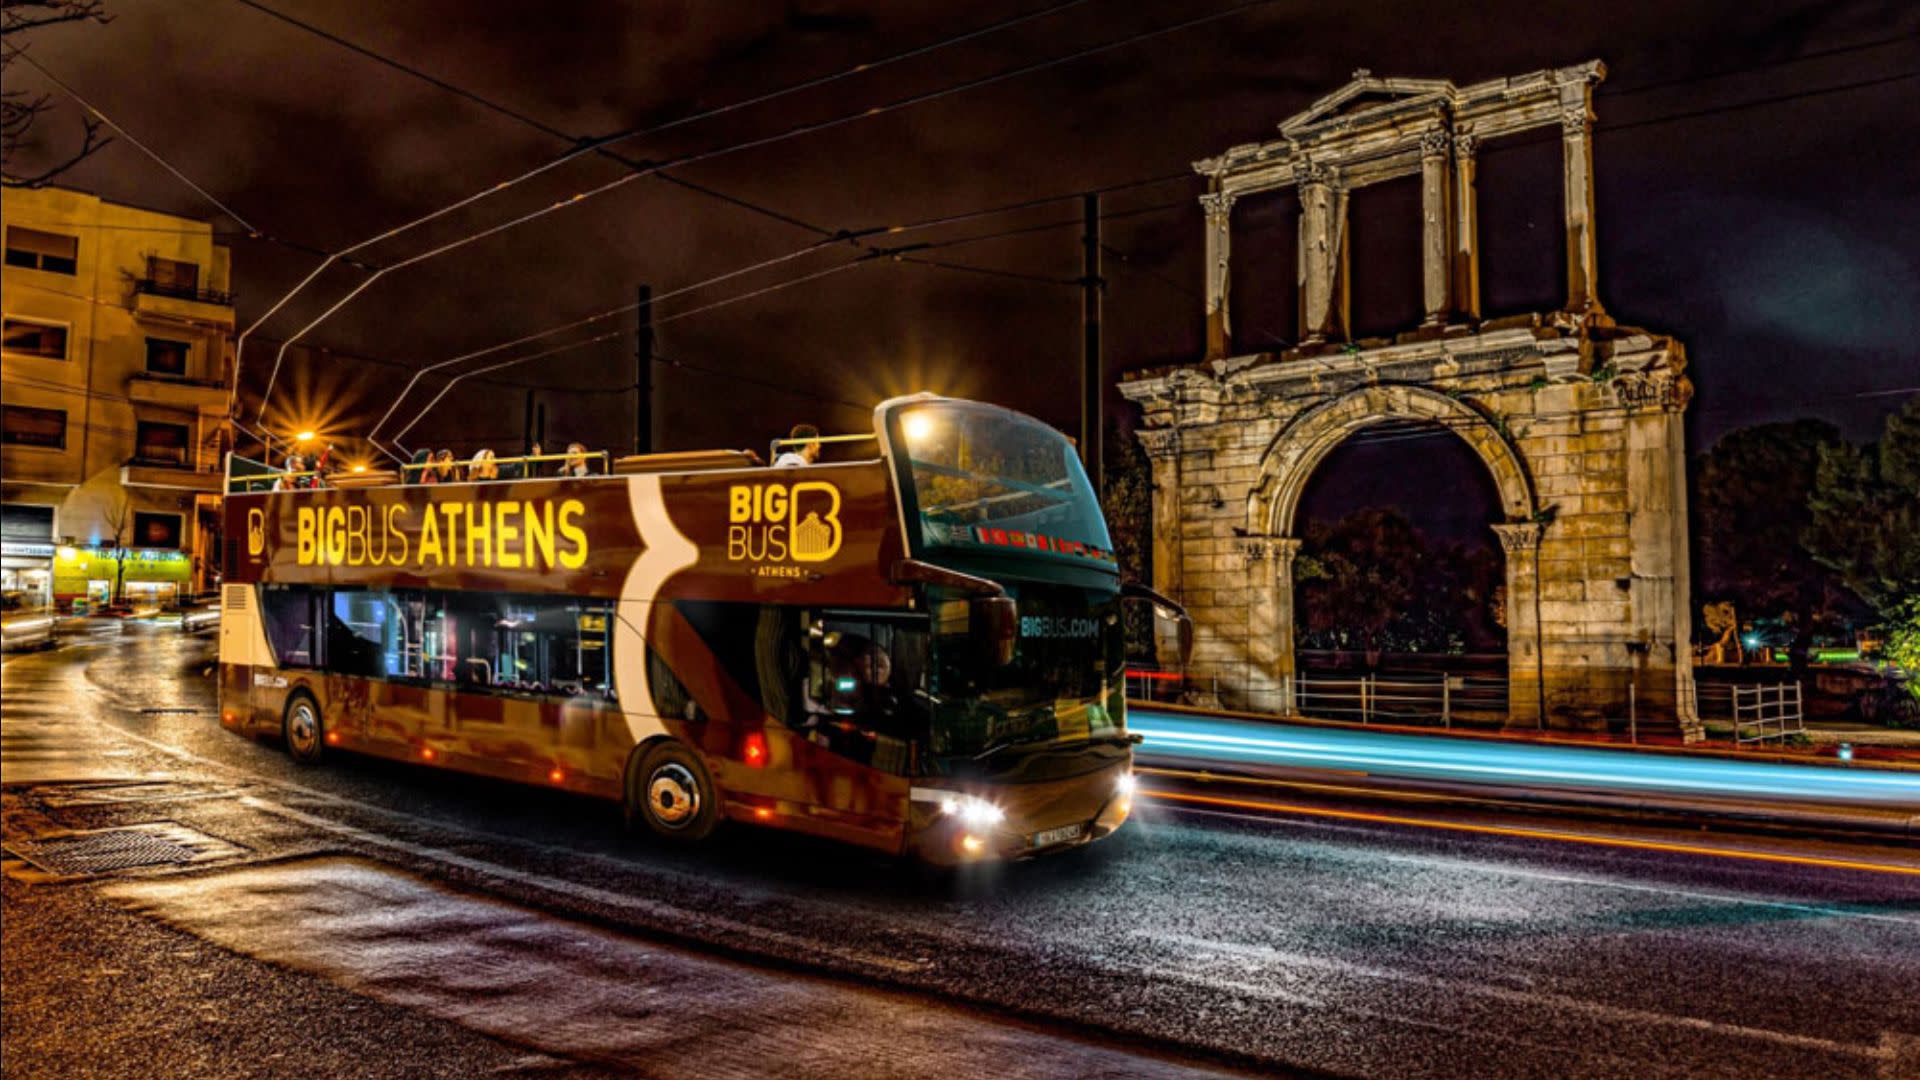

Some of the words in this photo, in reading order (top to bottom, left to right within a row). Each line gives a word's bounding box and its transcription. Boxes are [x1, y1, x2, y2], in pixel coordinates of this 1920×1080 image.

[729, 484, 788, 523] BIG
[417, 499, 588, 570] ATHENS
[728, 525, 787, 561] BUS
[96, 550, 139, 561] TRAL
[758, 566, 800, 577] ATHENS
[1021, 616, 1100, 639] BIGBUS.COM
